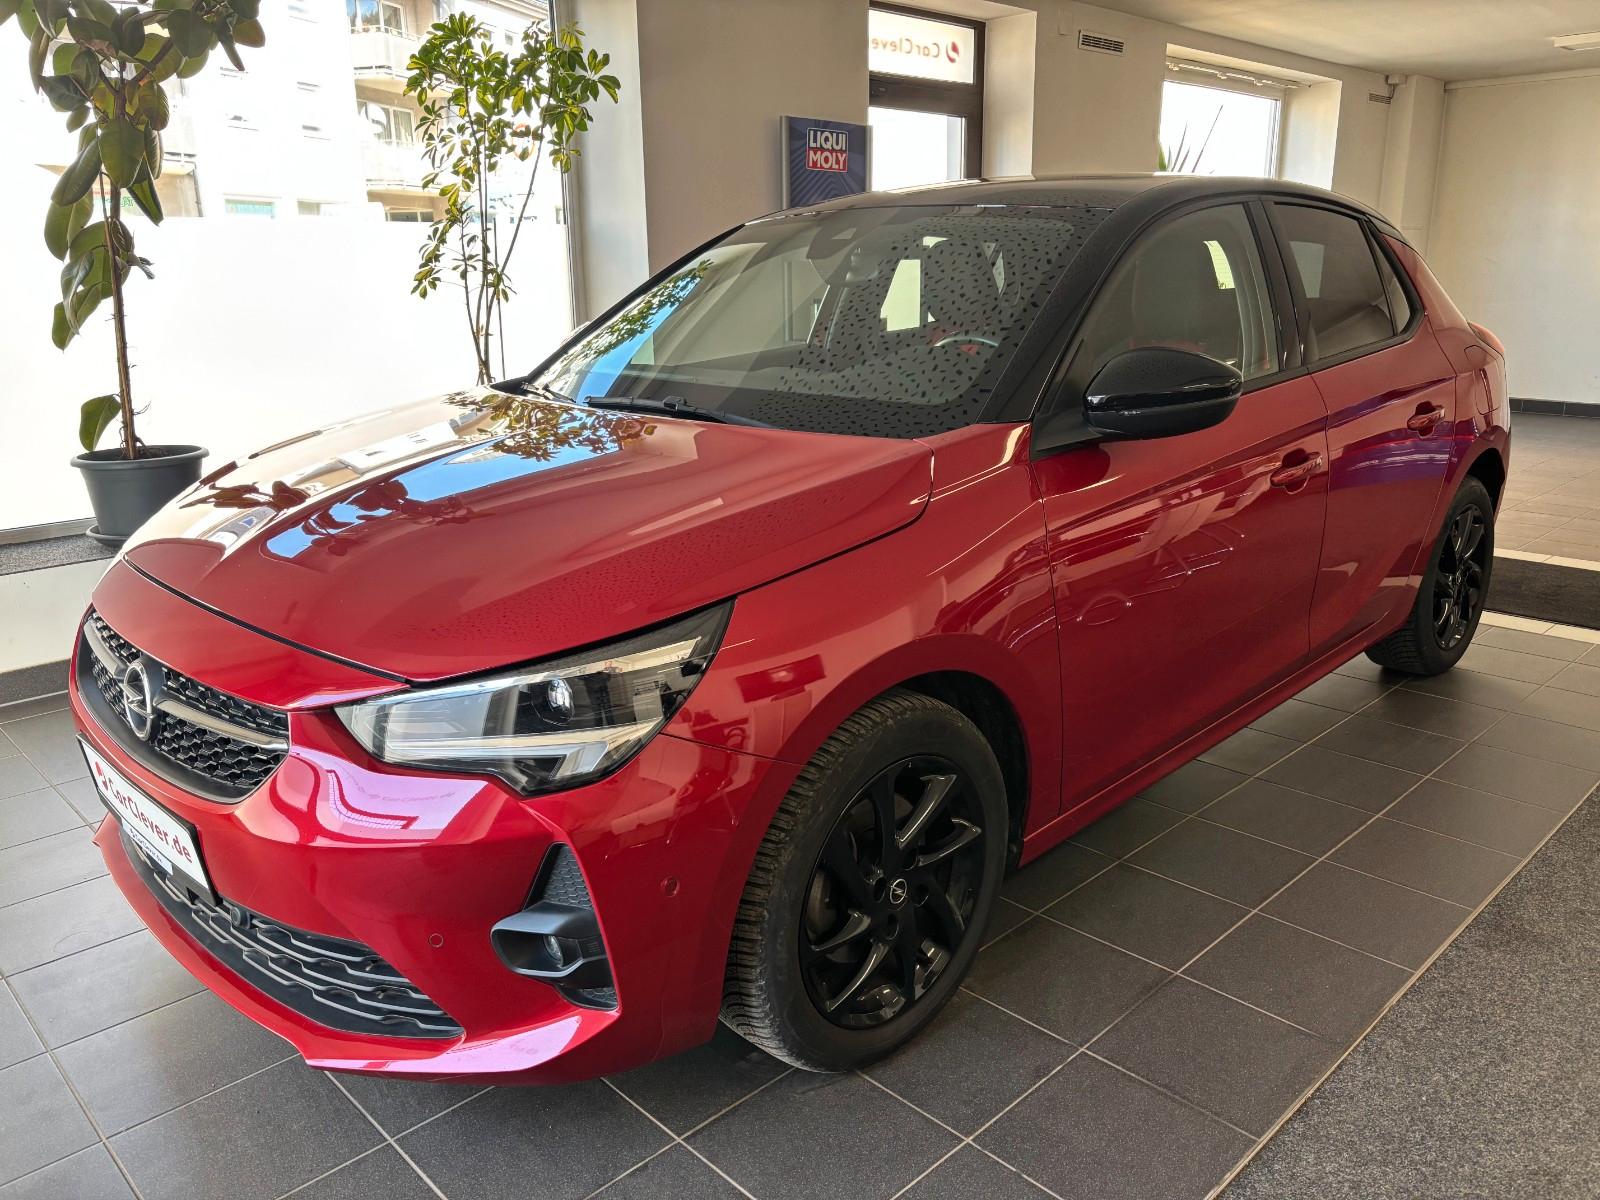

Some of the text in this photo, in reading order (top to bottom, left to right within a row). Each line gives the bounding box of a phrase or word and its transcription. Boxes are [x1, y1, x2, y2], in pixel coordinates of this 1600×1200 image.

[809, 130, 846, 150] LIQUI
[808, 150, 846, 169] MOLY
[108, 777, 193, 864] CarClever.de
